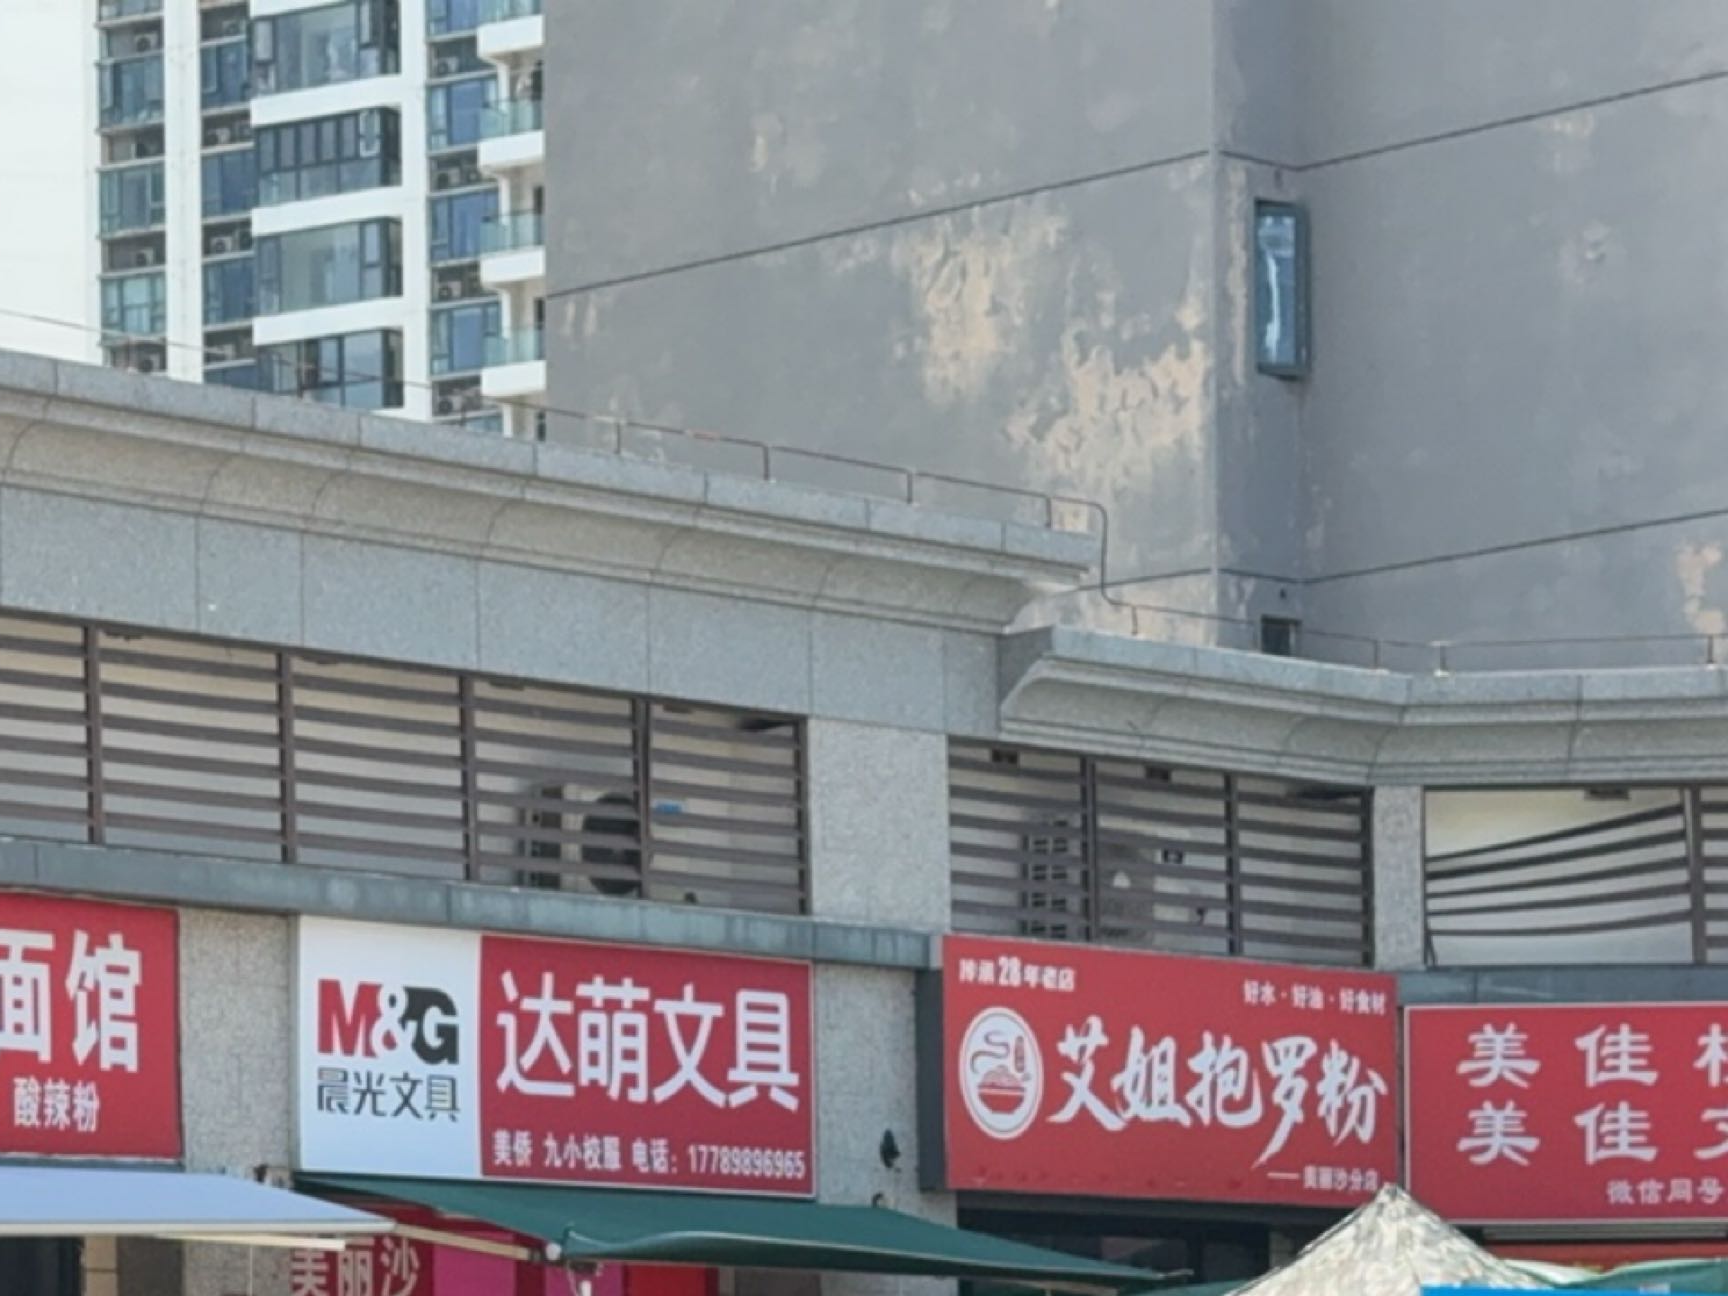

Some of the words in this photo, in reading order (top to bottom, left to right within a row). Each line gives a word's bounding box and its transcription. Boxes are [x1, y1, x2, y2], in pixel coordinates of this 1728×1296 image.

[317, 978, 460, 1065] M&G
[496, 969, 801, 1112] 达萌文具
[13, 1075, 100, 1132] 酸辣粉
[317, 1067, 461, 1122] 晨光文具
[1046, 1015, 1388, 1169] 艾姐抱罗粉
